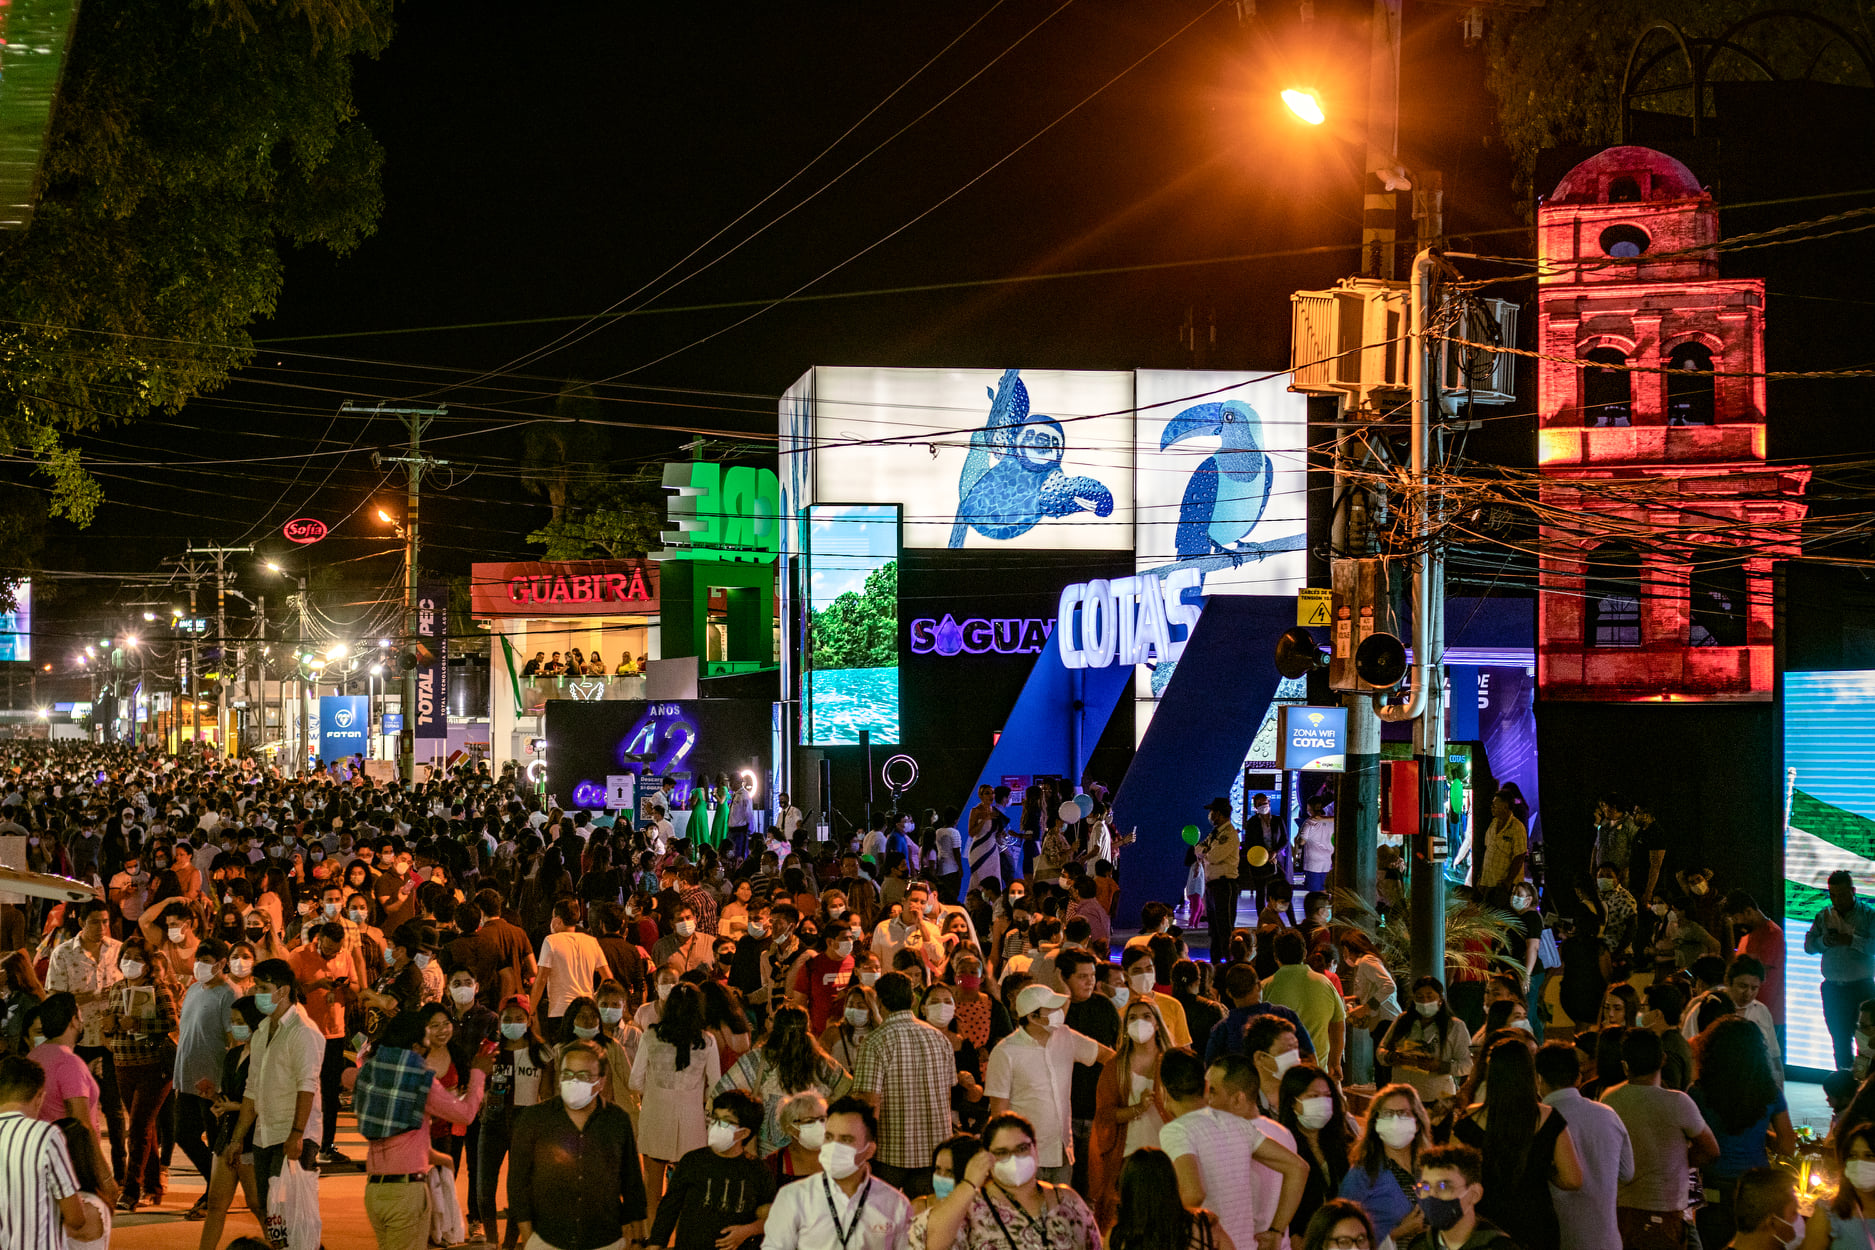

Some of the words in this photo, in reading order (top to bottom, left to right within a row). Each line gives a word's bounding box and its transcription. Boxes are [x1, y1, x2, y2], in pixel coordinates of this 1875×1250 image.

[288, 523, 323, 538] Sofía
[1058, 567, 1203, 669] COTAS
[418, 669, 434, 726] TOTAL
[650, 704, 681, 716] AÑOS
[1293, 728, 1317, 737] ZONA
[624, 720, 695, 780] 42
[1292, 737, 1336, 748] COTAS
